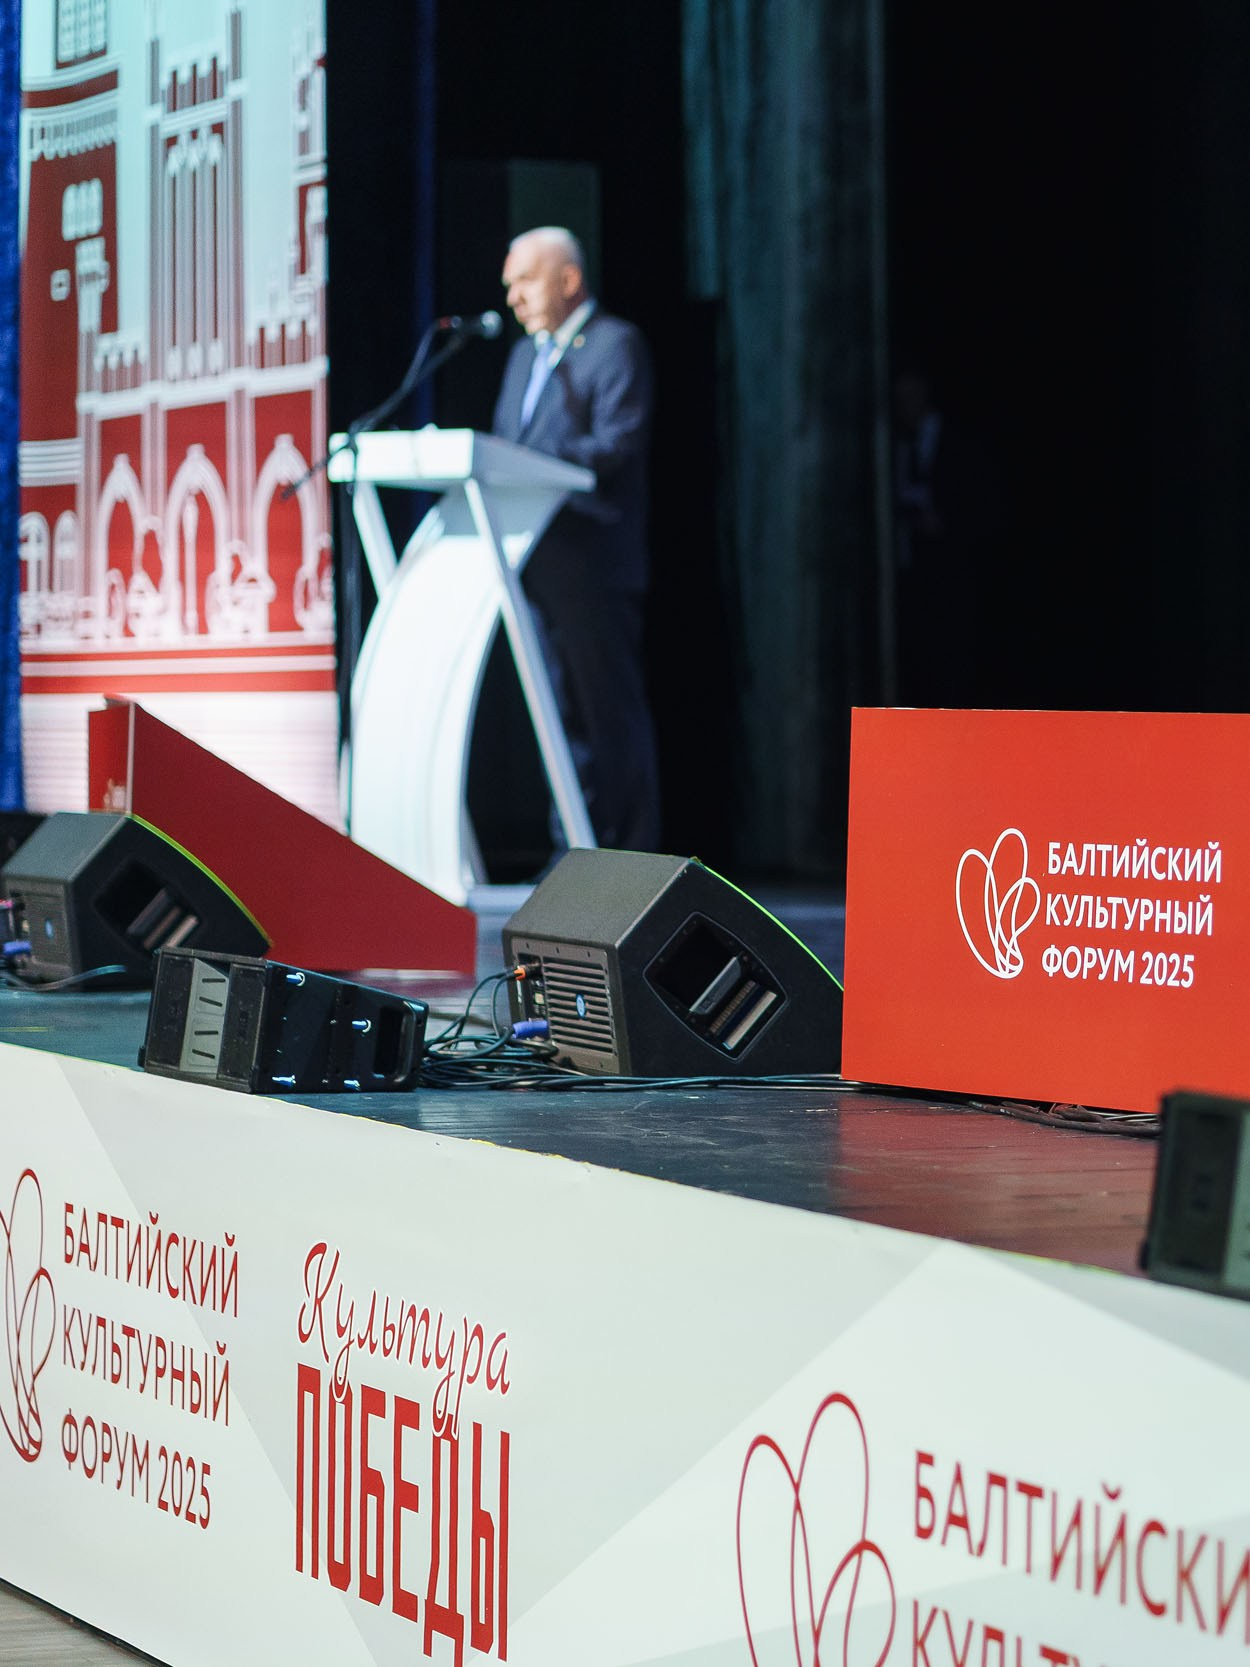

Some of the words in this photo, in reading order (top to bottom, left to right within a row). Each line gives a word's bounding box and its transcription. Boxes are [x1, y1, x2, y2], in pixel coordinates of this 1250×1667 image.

[1045, 893, 1213, 936] КУЛЬТУРНЫЙ
[1047, 838, 1222, 884] БАЛТИЙСКИЙ
[1041, 944, 1135, 983] ФОРУМ
[1139, 951, 1195, 989] 2025
[63, 1202, 239, 1318] БАЛТИЙСКИЙ
[62, 1304, 231, 1427] КУЛЬТУРНЫЙ
[297, 1242, 510, 1436] Культура
[61, 1407, 151, 1504] ФОРУМ
[157, 1446, 212, 1530] 2025
[296, 1363, 511, 1667] ПОБЕДЫ
